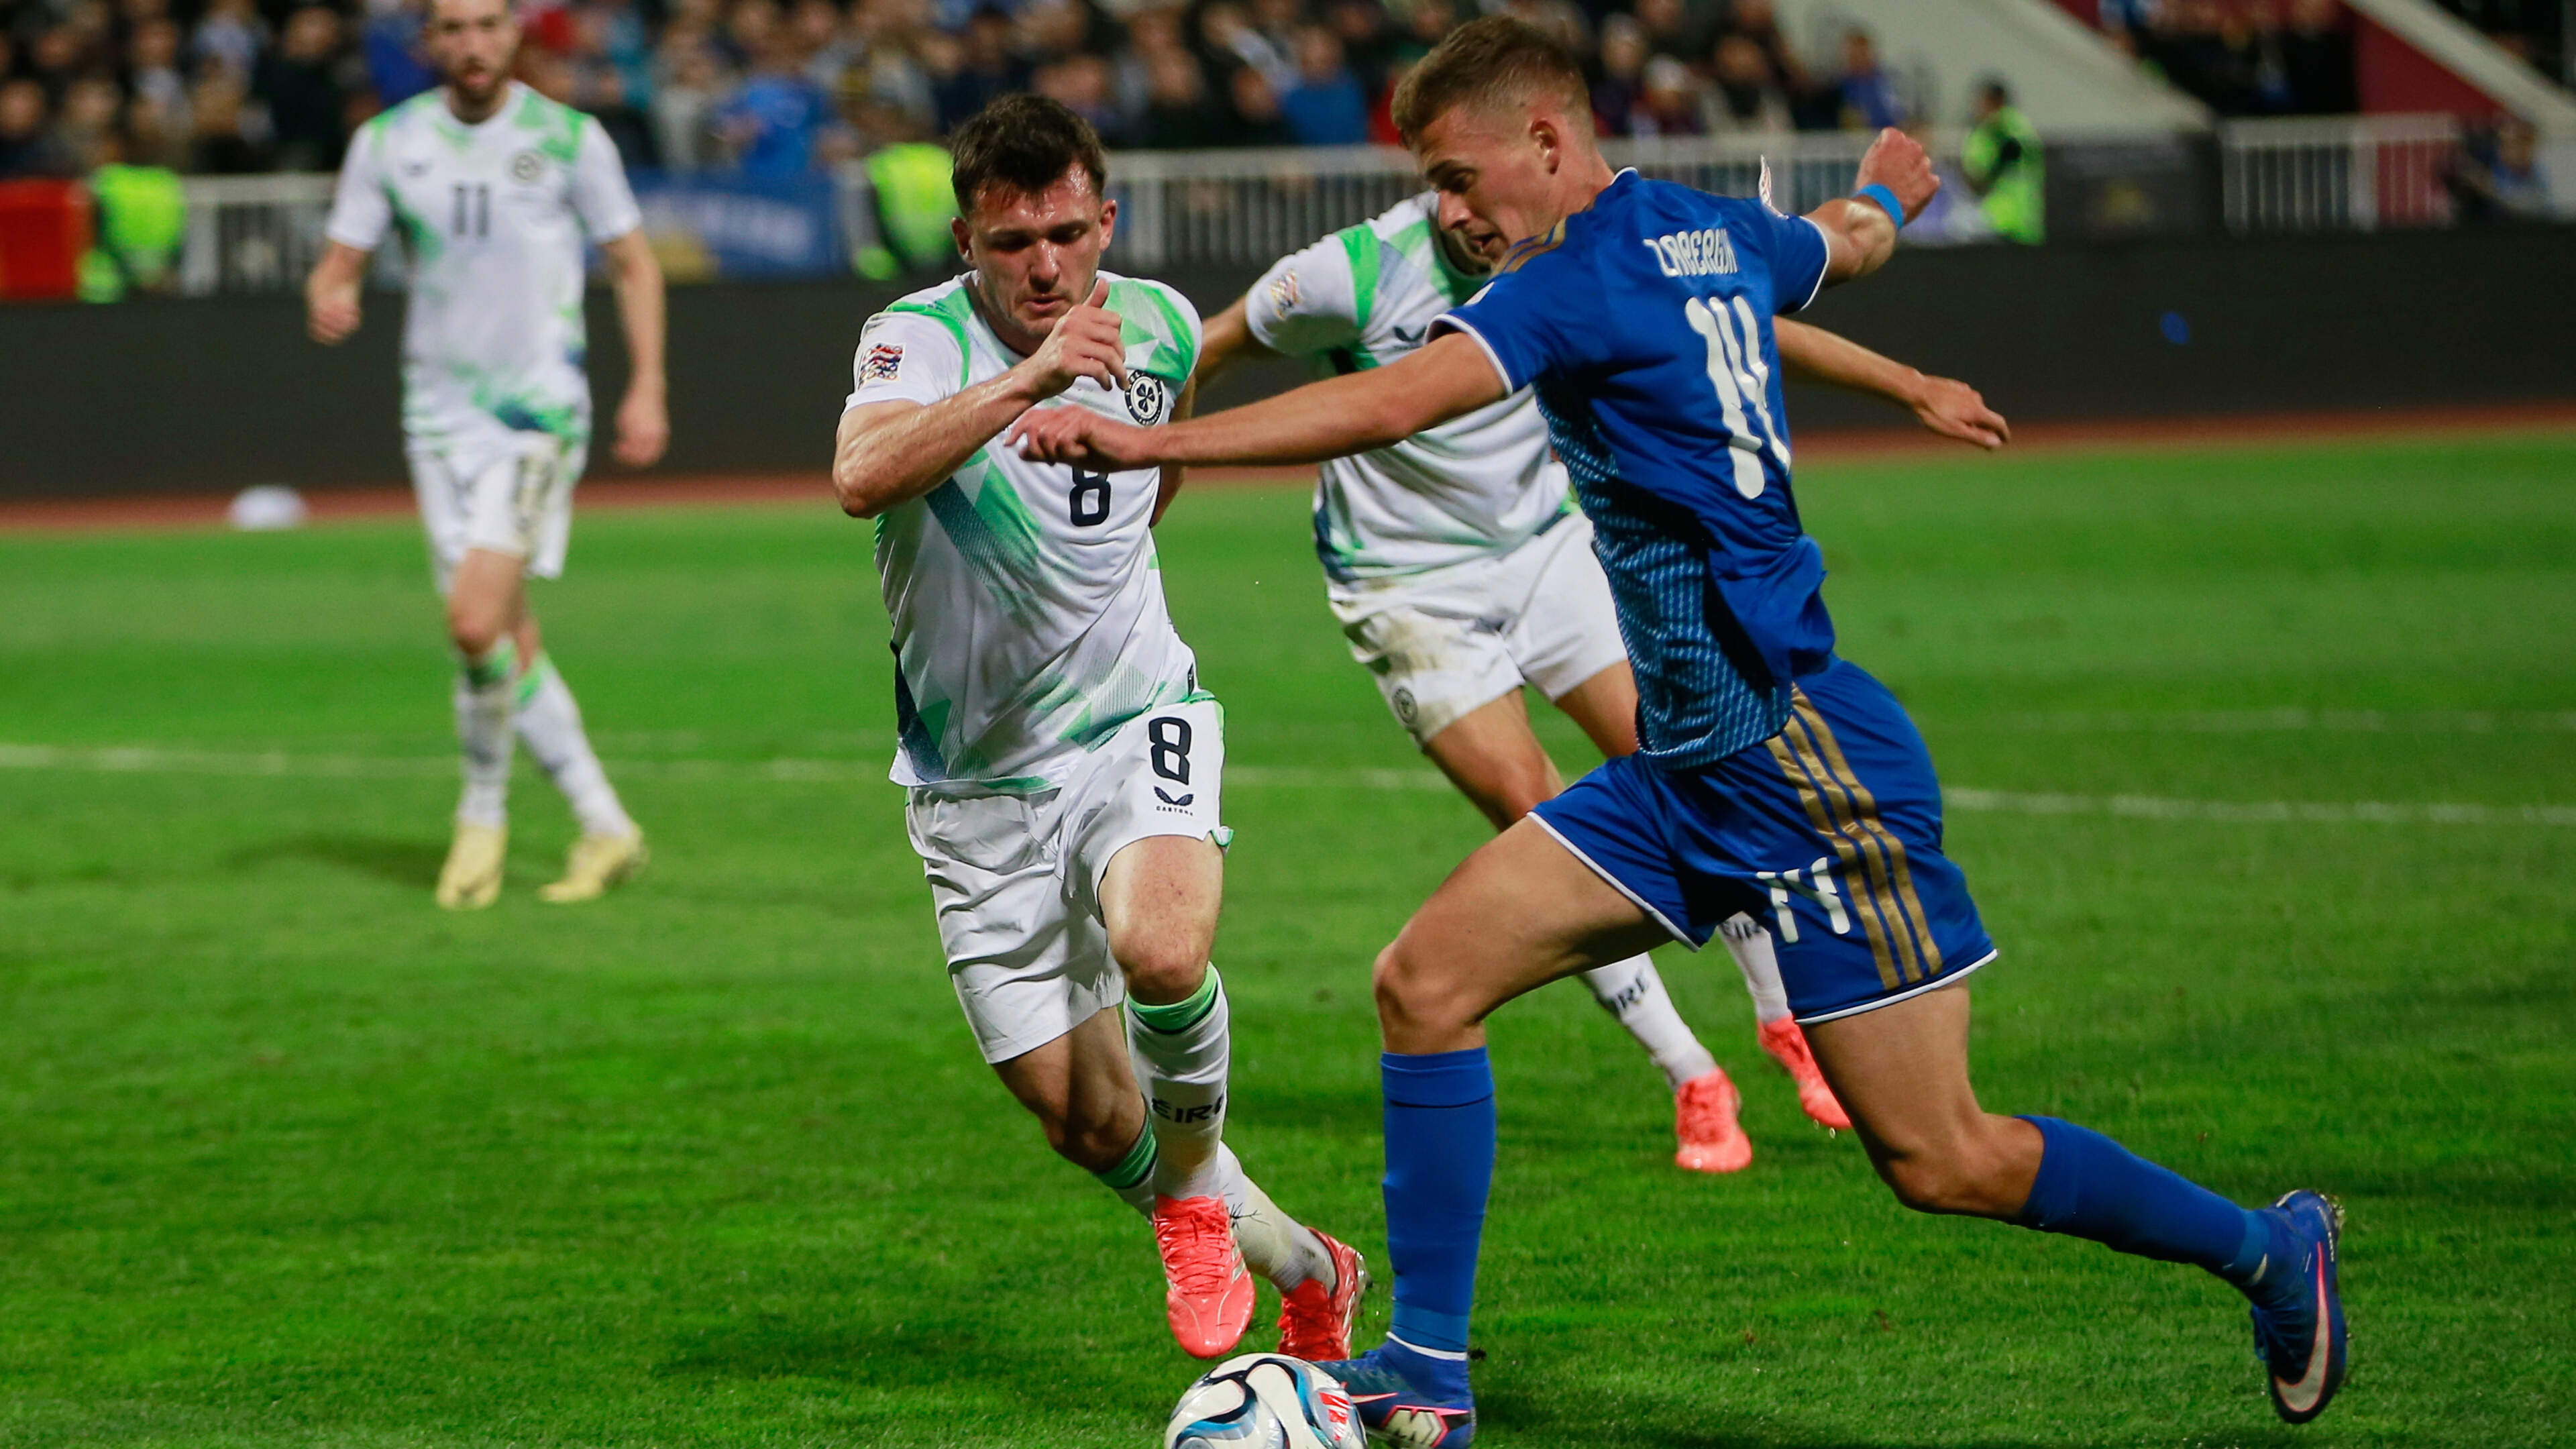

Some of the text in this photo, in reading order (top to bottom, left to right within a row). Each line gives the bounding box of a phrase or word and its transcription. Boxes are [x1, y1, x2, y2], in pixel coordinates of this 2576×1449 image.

[451, 182, 490, 237] 11
[1685, 296, 1792, 500] 14
[1069, 467, 1111, 527] 8
[1148, 716, 1191, 786] 8
